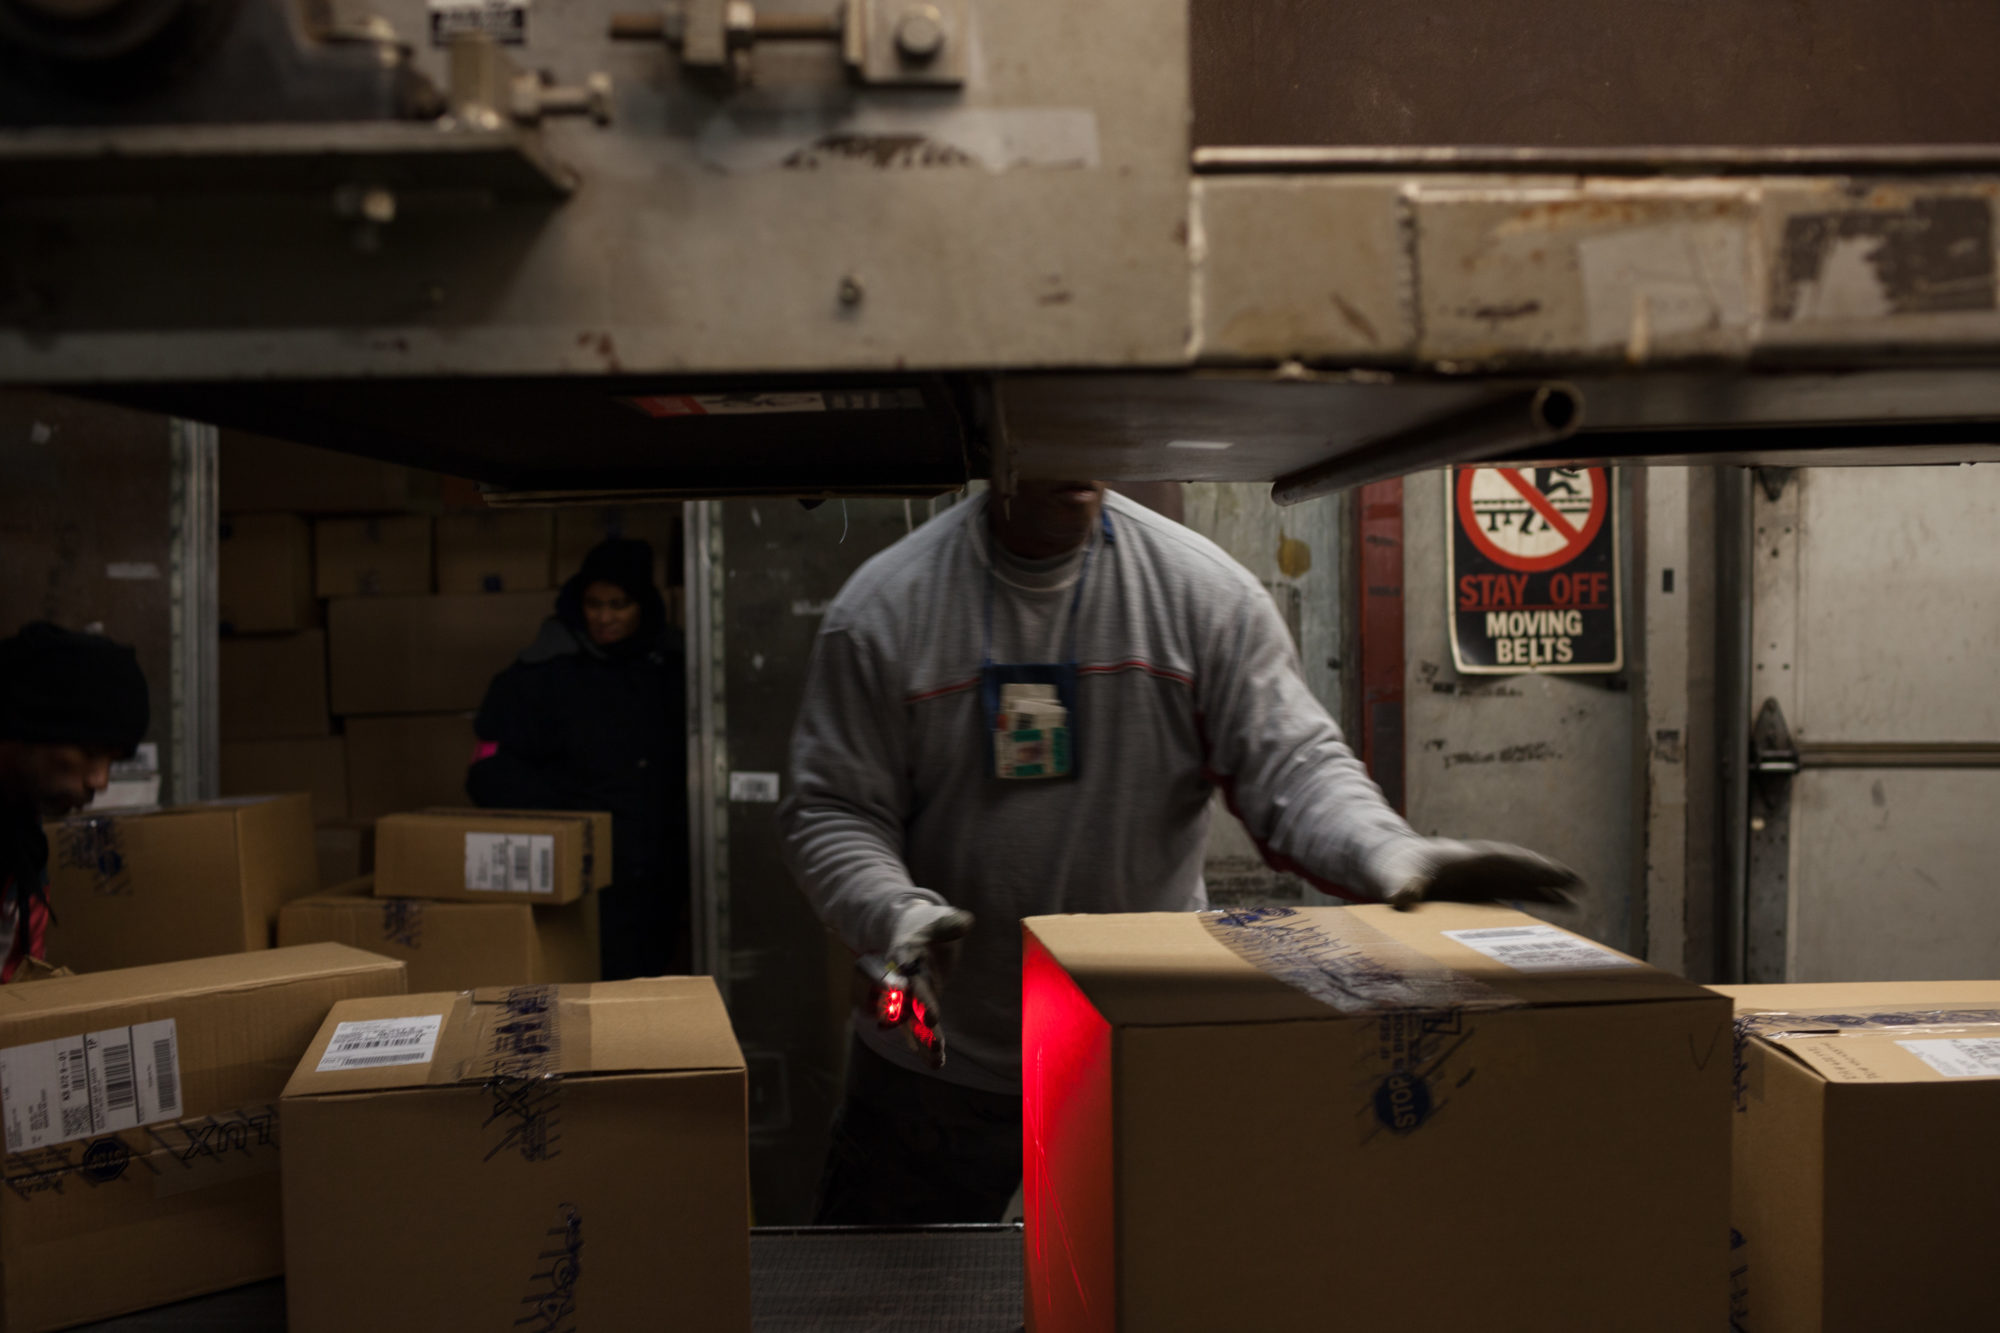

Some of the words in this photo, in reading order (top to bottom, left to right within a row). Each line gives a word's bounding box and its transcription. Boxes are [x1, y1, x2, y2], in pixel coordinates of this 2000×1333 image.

[1459, 573, 1529, 606] STAY
[1550, 572, 1608, 604] OFF
[1486, 610, 1582, 637] MOVING
[1496, 637, 1573, 663] BELTS
[1388, 1075, 1418, 1129] STOP
